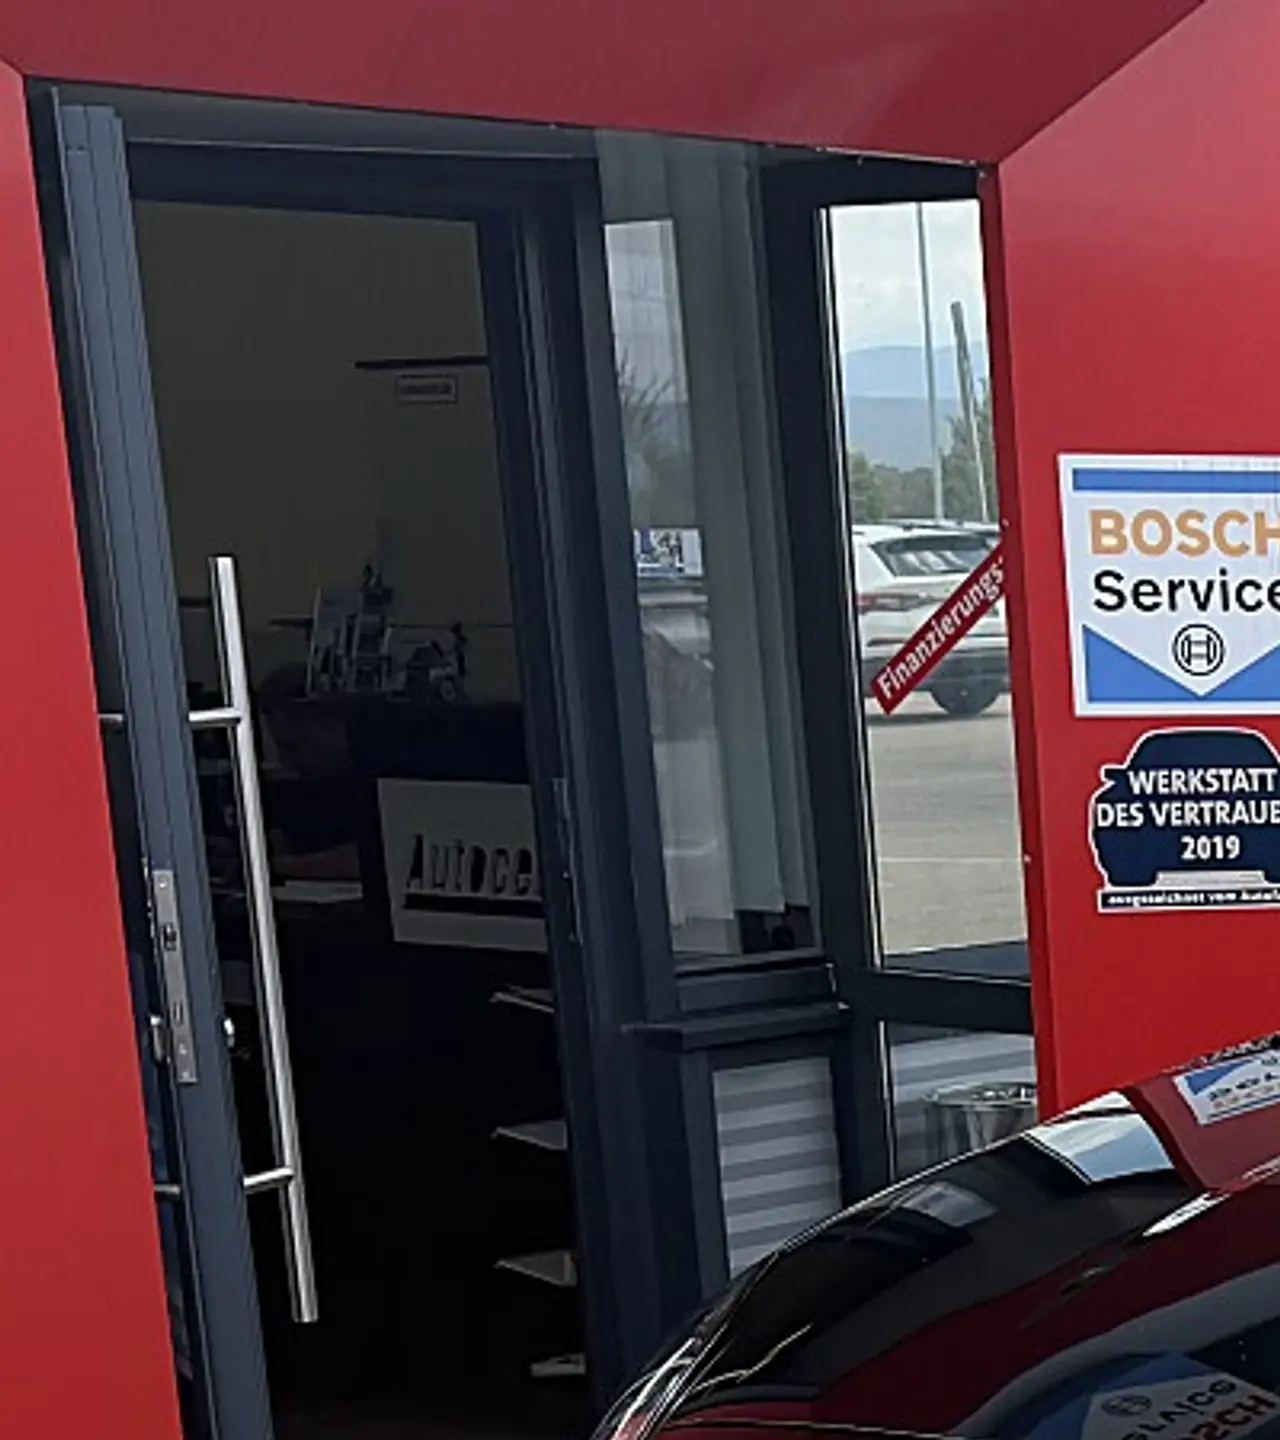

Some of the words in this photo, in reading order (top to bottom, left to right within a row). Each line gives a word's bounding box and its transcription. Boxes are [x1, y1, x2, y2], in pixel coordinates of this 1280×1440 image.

[876, 555, 1004, 700] Finanzierungs
[1128, 767, 1278, 795] WERKSTATT
[1096, 802, 1145, 828] DES
[1180, 835, 1241, 860] 2019
